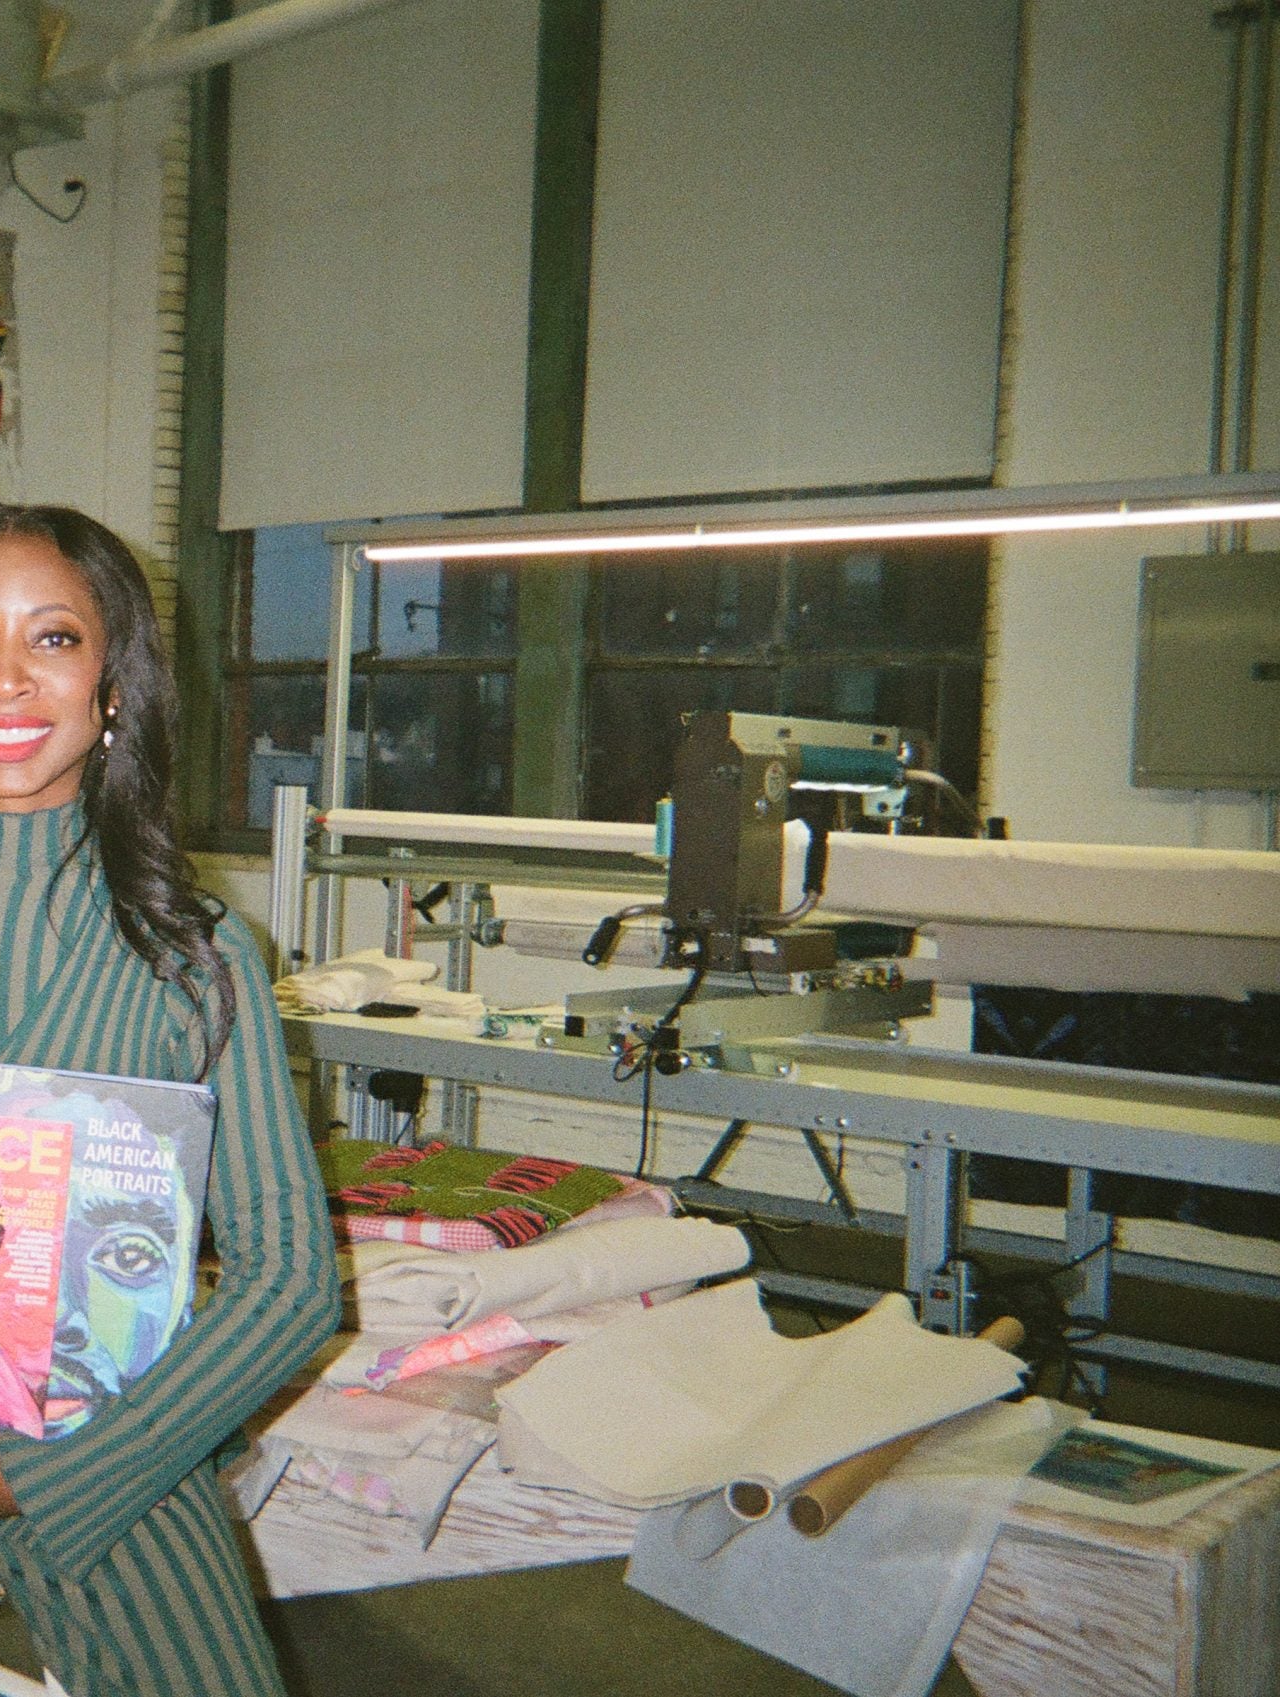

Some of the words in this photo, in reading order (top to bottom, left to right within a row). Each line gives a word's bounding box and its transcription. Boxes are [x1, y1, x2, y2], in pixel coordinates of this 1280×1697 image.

[87, 1118, 142, 1141] BLACK
[83, 1142, 175, 1170] AMERICAN
[81, 1166, 172, 1195] PORTRAITS
[2, 1187, 23, 1199] THE
[27, 1189, 57, 1201] YEAR
[28, 1200, 56, 1211] THAT
[0, 1207, 55, 1220] CHANGED
[11, 1217, 55, 1229] WORLD
